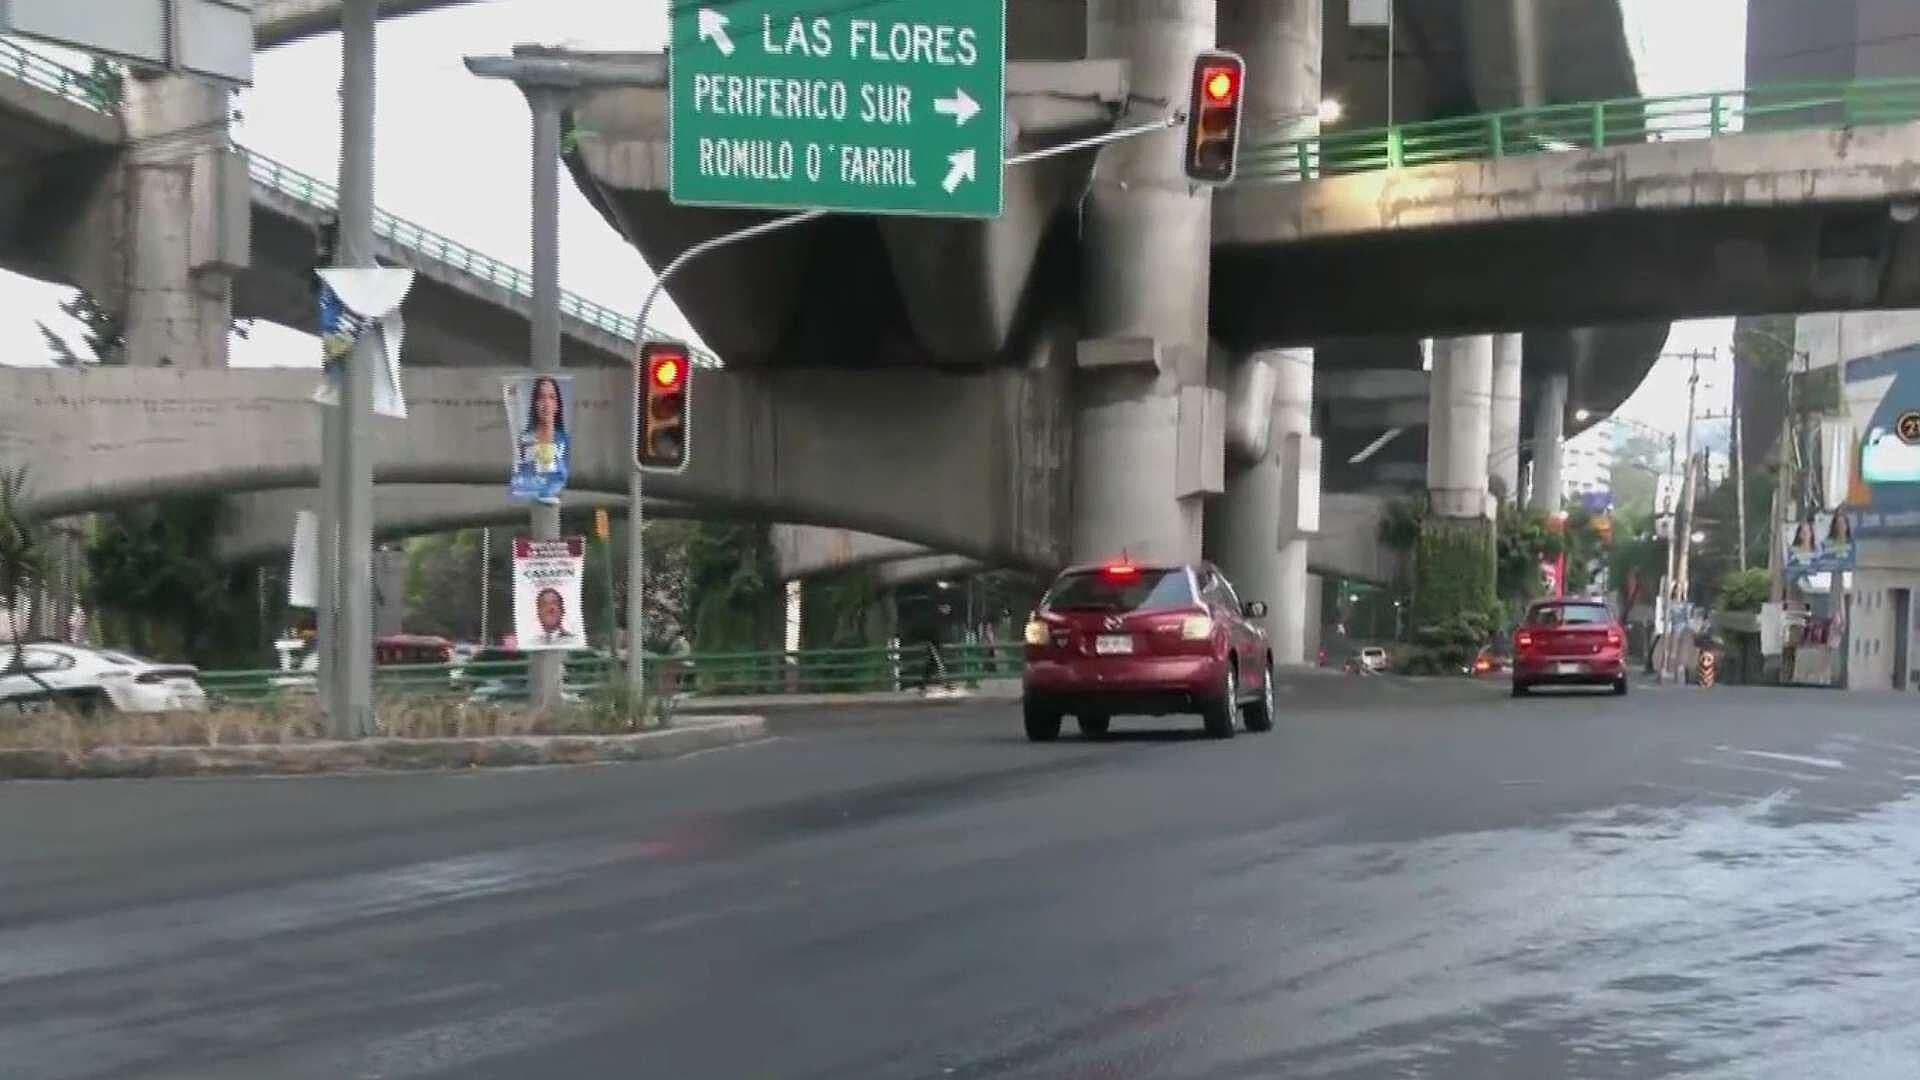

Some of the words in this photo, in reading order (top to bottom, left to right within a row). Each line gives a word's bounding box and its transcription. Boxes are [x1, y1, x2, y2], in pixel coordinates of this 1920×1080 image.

[762, 14, 832, 57] LAS
[848, 20, 977, 65] FLORES
[693, 73, 848, 120] PERIFERICO
[860, 83, 912, 125] SUR
[699, 138, 793, 181] ROMULO
